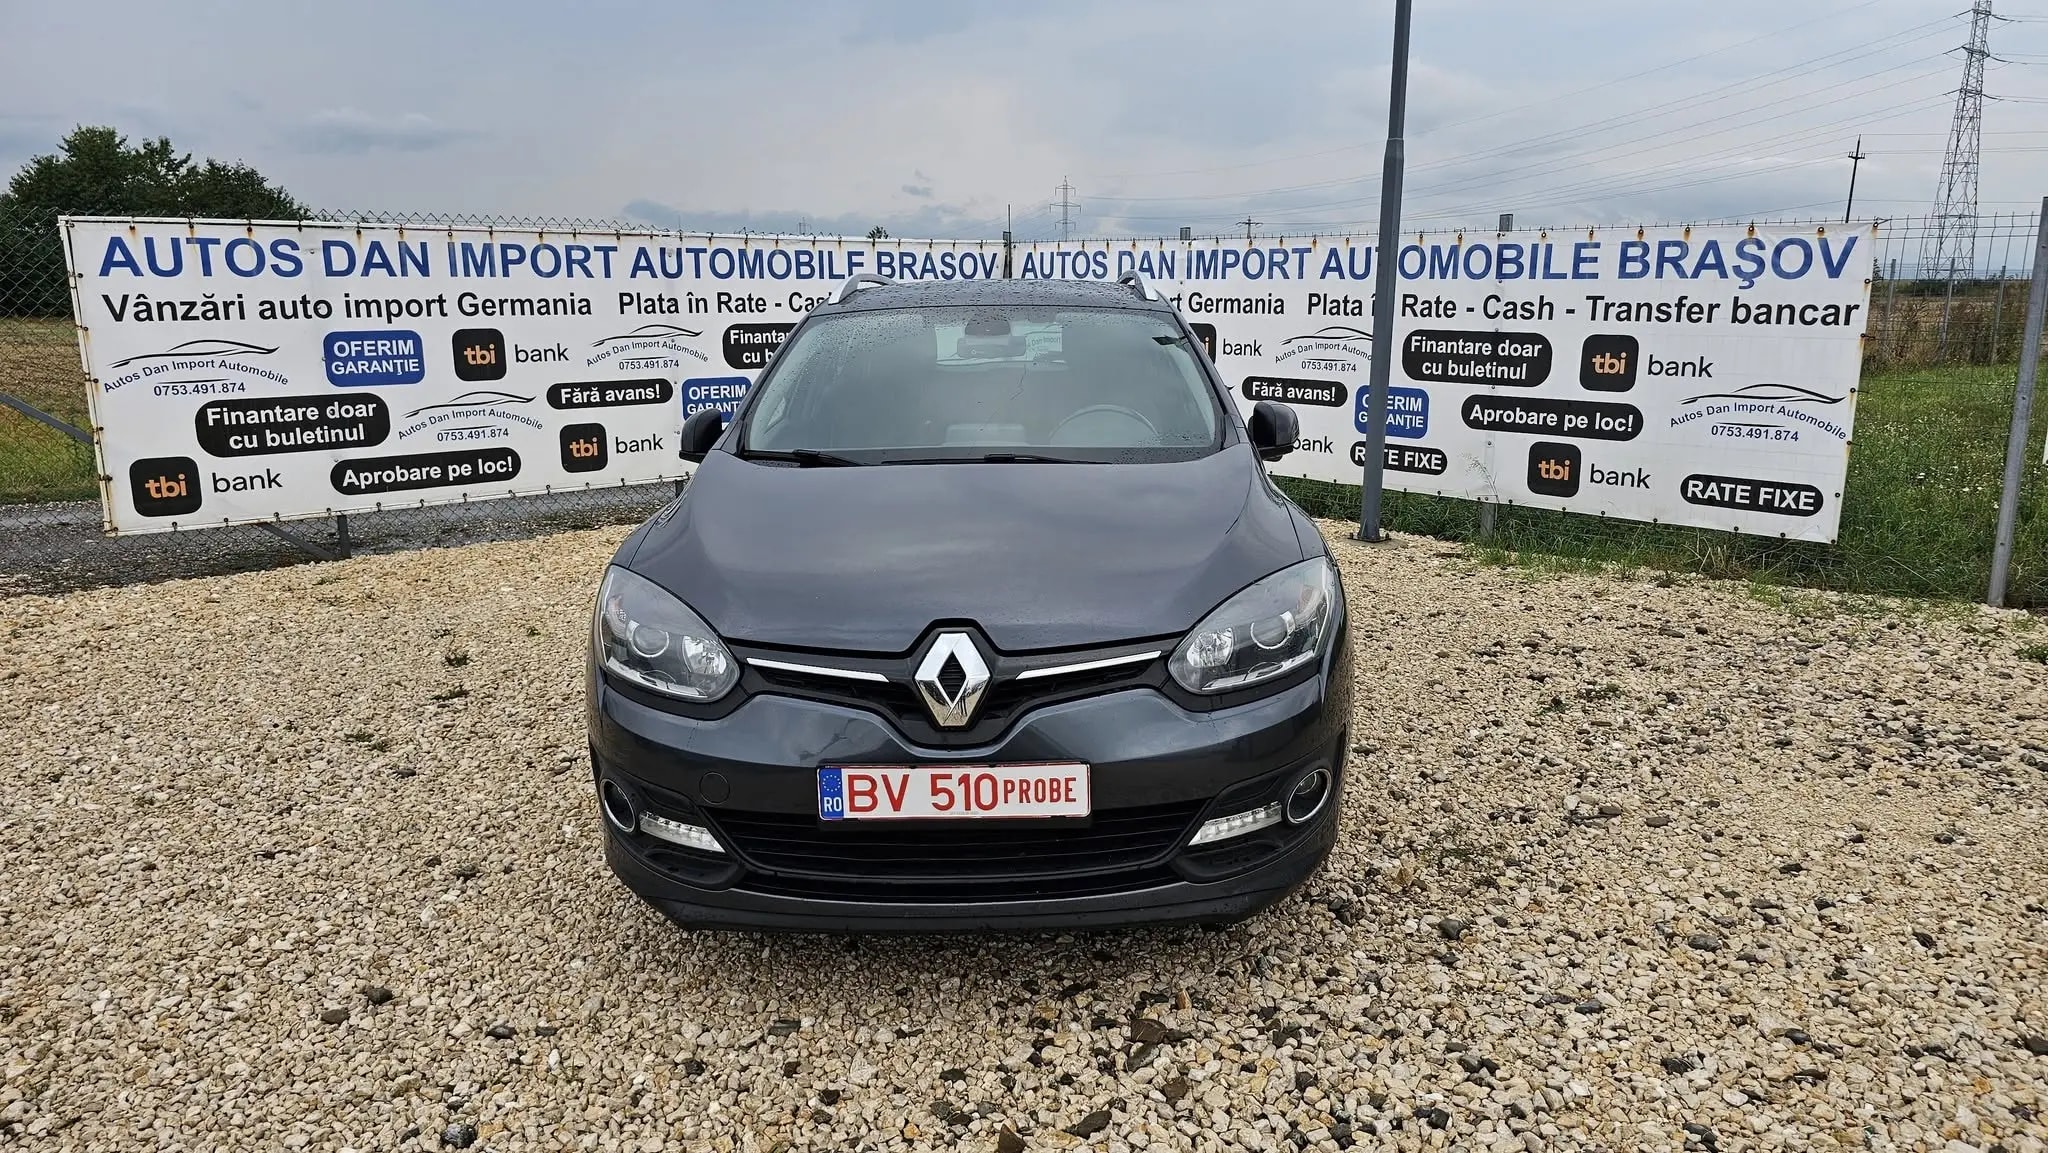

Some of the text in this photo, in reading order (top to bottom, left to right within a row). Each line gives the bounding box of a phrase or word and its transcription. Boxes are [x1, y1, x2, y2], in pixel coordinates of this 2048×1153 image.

[99, 236, 303, 278] AUTOS
[322, 240, 430, 278] DAN
[448, 242, 618, 279] IMPORT
[630, 246, 864, 280] AUTOMOBILE
[1021, 236, 1858, 289] AUTOS DAN IMPORT AUOMOBILE BRAŞOV
[102, 293, 245, 322] Vânzări
[259, 295, 333, 321] auto
[344, 293, 448, 324] import
[457, 292, 592, 317] Germania
[619, 292, 679, 315] Plata
[687, 292, 708, 315] în
[717, 293, 767, 313] Rate
[1189, 292, 1285, 314] Germania
[1308, 293, 1363, 317] Plata
[1401, 294, 1457, 318] Rate
[1483, 294, 1554, 321] Cash
[1586, 295, 1720, 323] Transfer
[1731, 297, 1859, 326] bancar
[730, 329, 791, 344] Finanta
[1223, 339, 1262, 356] bank
[1410, 336, 1542, 357] Finantare doar
[334, 340, 414, 357] OFERIM
[464, 343, 569, 366] tbi bank
[586, 341, 708, 367] Autos Dan Import Automobile
[742, 352, 760, 363] cu
[1275, 349, 1296, 364] Autos
[1298, 344, 1313, 353] Dan
[1315, 342, 1340, 350] Import
[103, 359, 289, 393] Autos Dan Import Automobile
[619, 360, 680, 370] 0753.491.874
[1302, 361, 1356, 372] 0753.491.874
[1422, 360, 1527, 380] cu buletinul
[1592, 351, 1713, 378] tbi bank
[153, 382, 246, 396] 0753.491.874
[561, 384, 661, 404] Fără avans!
[688, 384, 746, 400] OFERIM
[1252, 382, 1336, 402] Fără avans!
[207, 401, 376, 427] Finantare doar
[398, 408, 543, 440] Autos Dan Import Automobile
[1358, 411, 1424, 429] GANŢIE
[1469, 404, 1634, 432] Aprobare pe loc!
[1669, 402, 1847, 440] Autos Dan Import Automobile
[229, 423, 365, 450] cu buletinul
[437, 428, 509, 441] 0753.491.874
[1711, 425, 1799, 442] 0753.491.874
[569, 434, 664, 458] tbi bank
[1404, 451, 1442, 470] FIXE
[144, 468, 282, 499] tbi bank
[342, 456, 513, 489] Aprobare pe loc!
[1538, 458, 1650, 489] tbi bank
[1687, 480, 1815, 511] RATE FIXE
[823, 797, 842, 812] RO
[847, 774, 910, 812] BV
